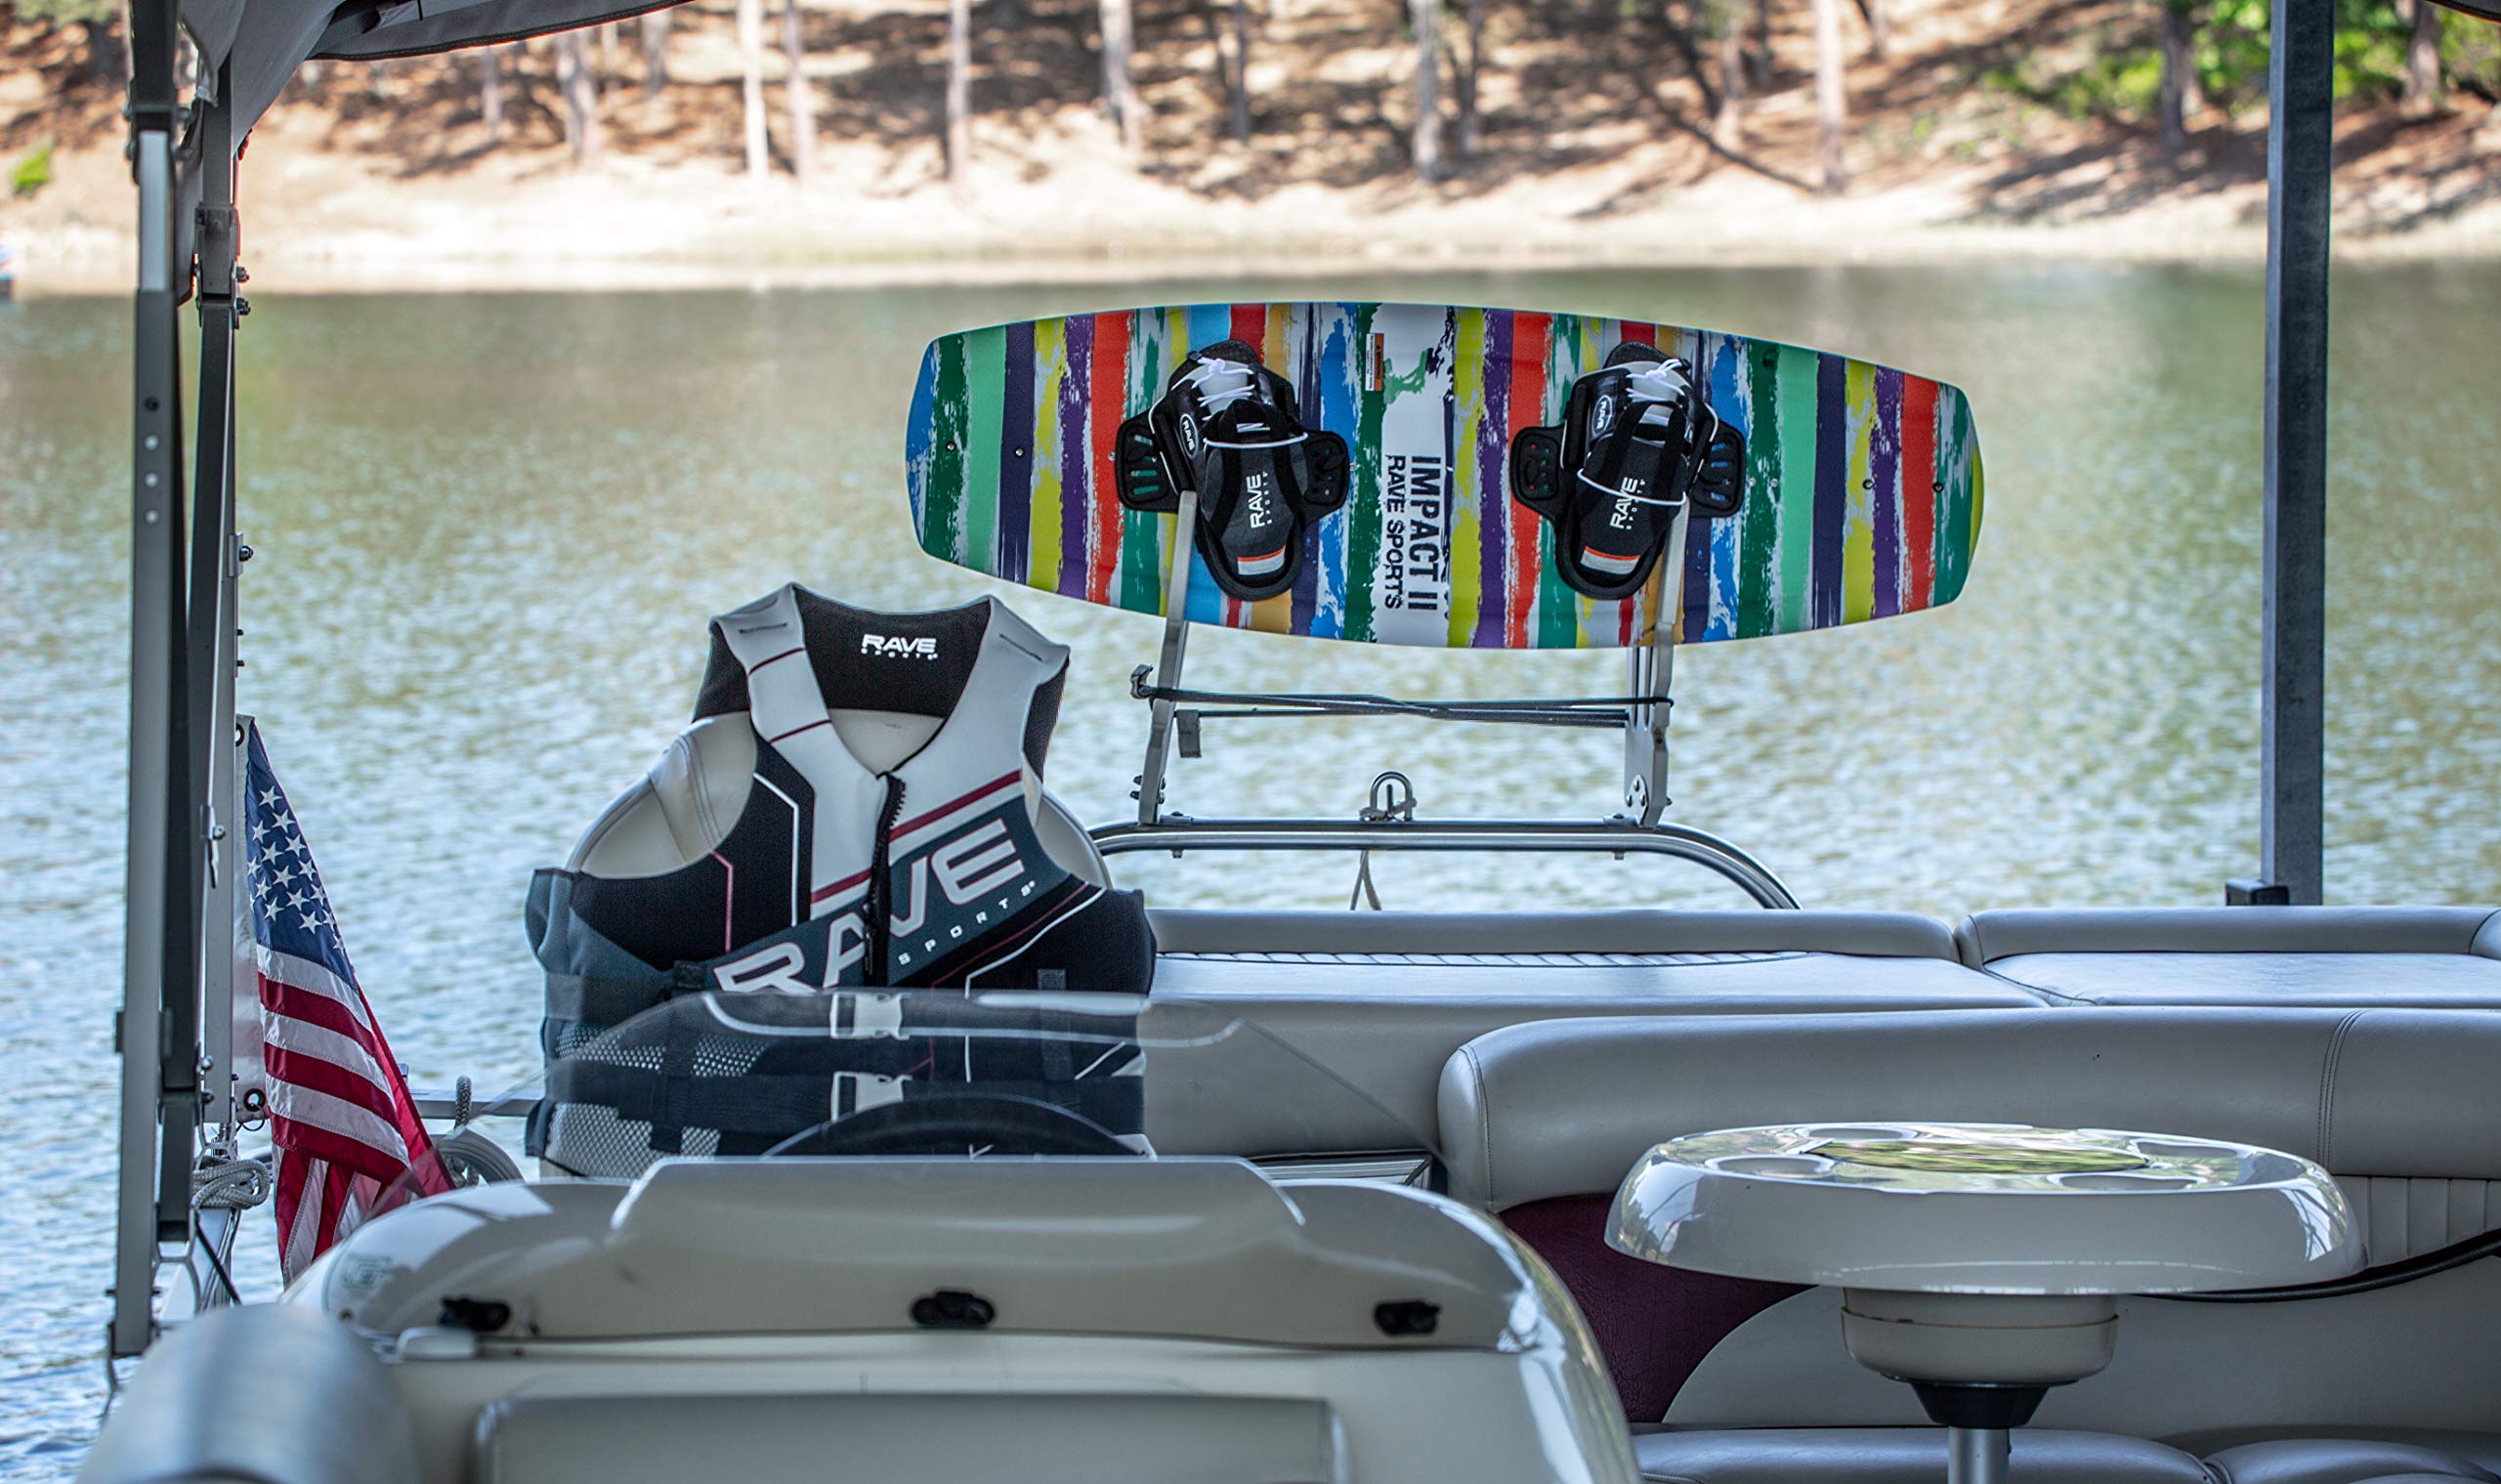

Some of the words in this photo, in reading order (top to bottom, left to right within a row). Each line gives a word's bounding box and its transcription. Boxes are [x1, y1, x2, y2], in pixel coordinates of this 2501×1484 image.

[1182, 419, 1195, 450] RAVE
[1594, 401, 1608, 429] RAVE
[1246, 474, 1266, 529] RAVE
[1385, 454, 1406, 513] RAVE
[1609, 477, 1639, 530] RAVE
[1409, 455, 1441, 582] IMPACT
[1384, 519, 1405, 609] SPORTS
[1408, 591, 1437, 610] II
[862, 633, 937, 654] RAVE
